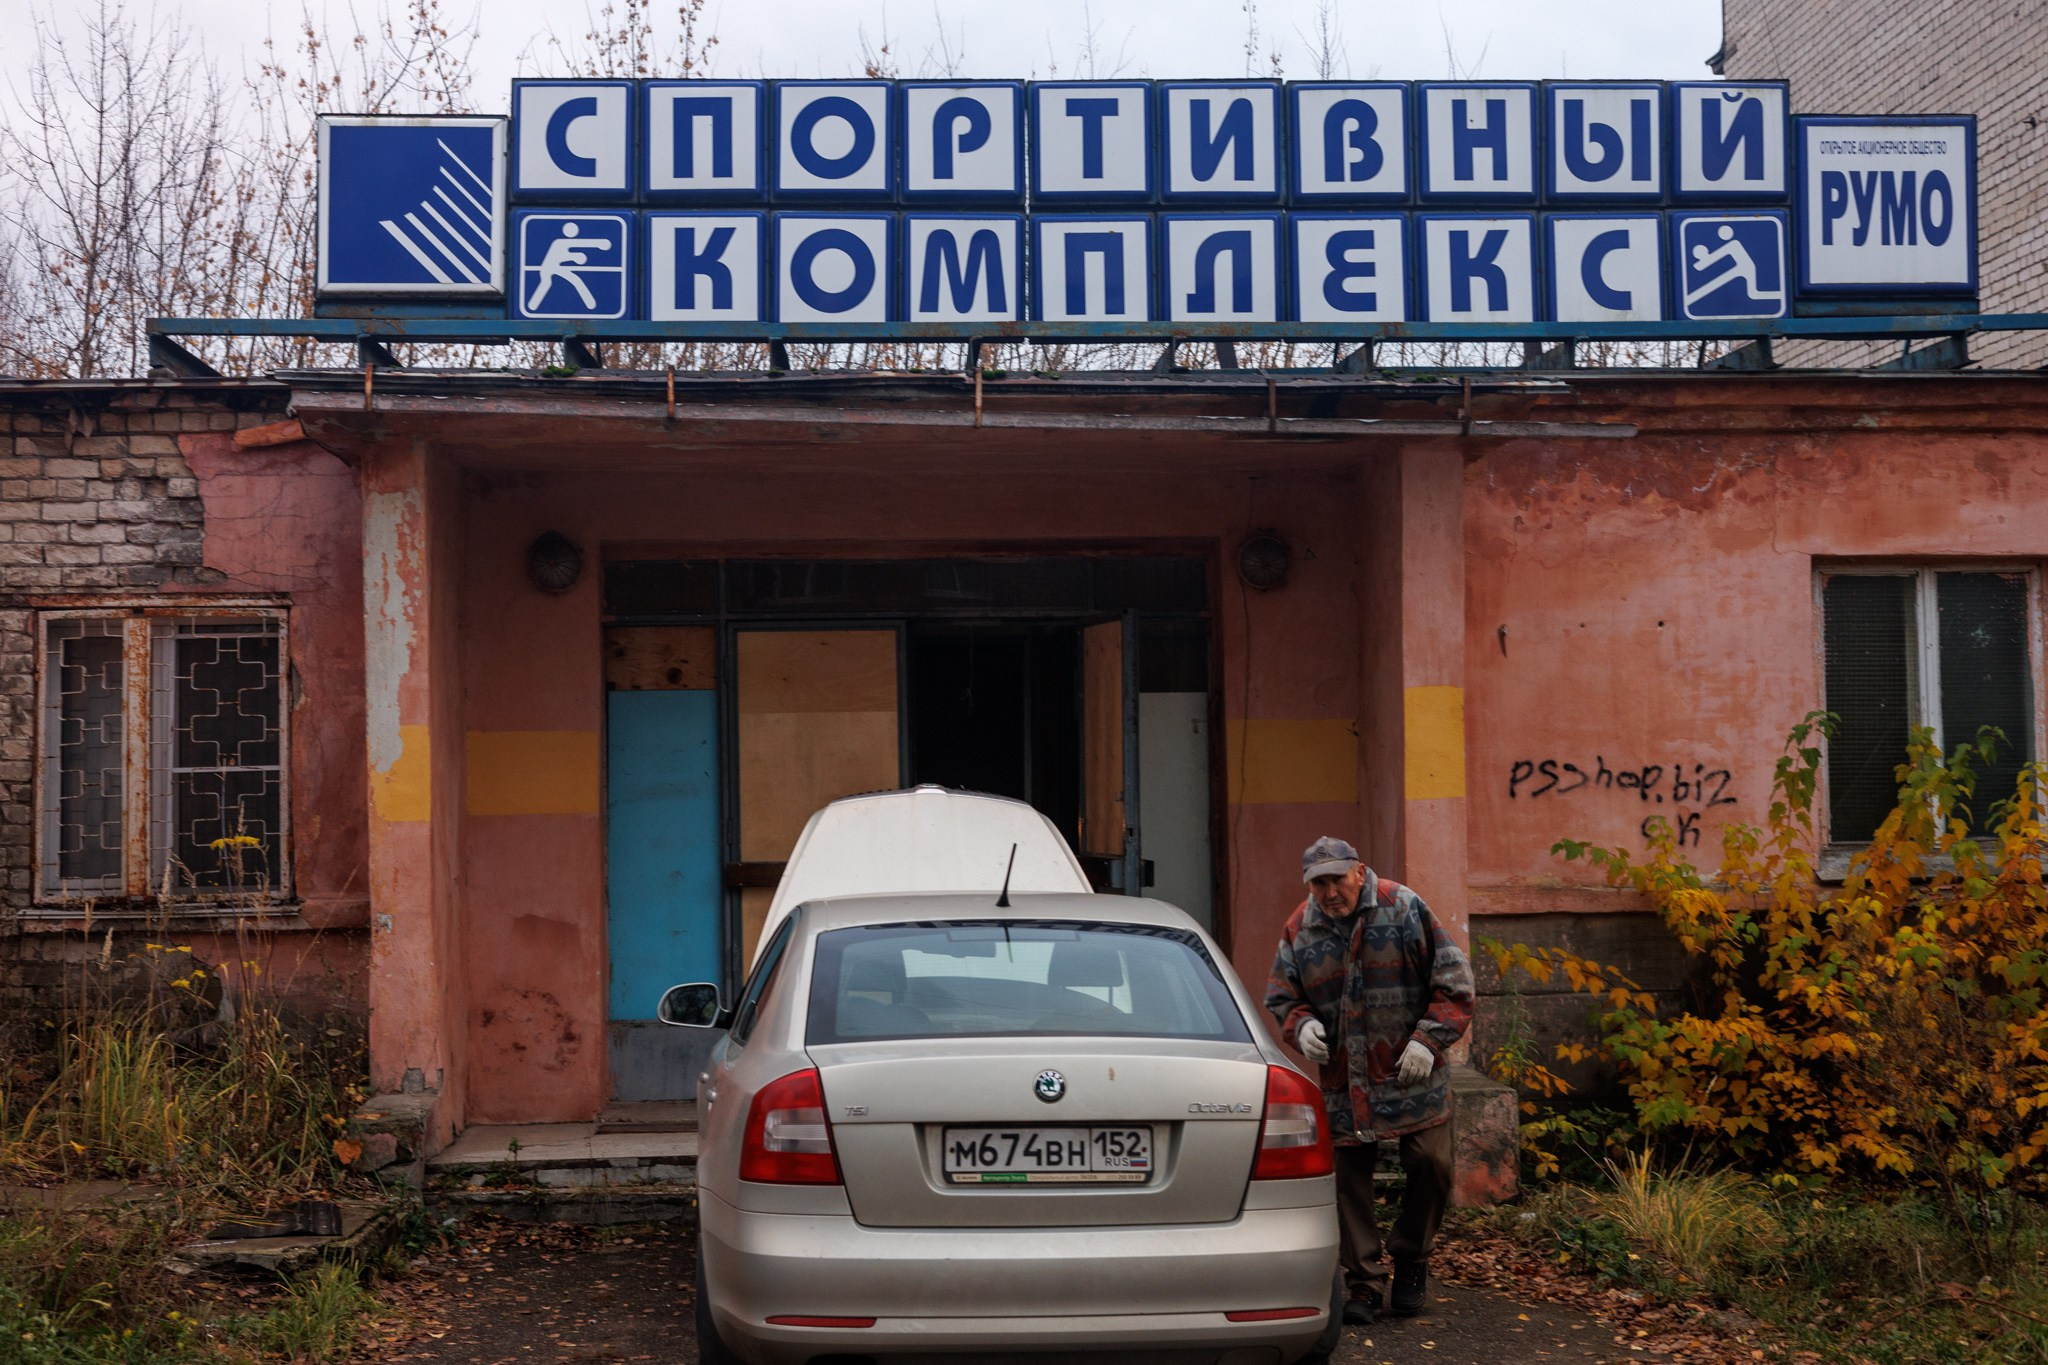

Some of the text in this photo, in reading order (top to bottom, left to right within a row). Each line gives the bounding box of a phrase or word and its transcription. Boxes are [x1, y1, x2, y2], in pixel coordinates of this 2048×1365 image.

[546, 91, 1764, 182] СПОРТИВНЫЙ
[1821, 169, 1953, 247] РУМО
[674, 226, 1632, 314] КОМПЛЕКС
[1188, 1101, 1253, 1114] Octavia
[1094, 1130, 1142, 1157] 152
[1105, 1157, 1130, 1167] RUS
